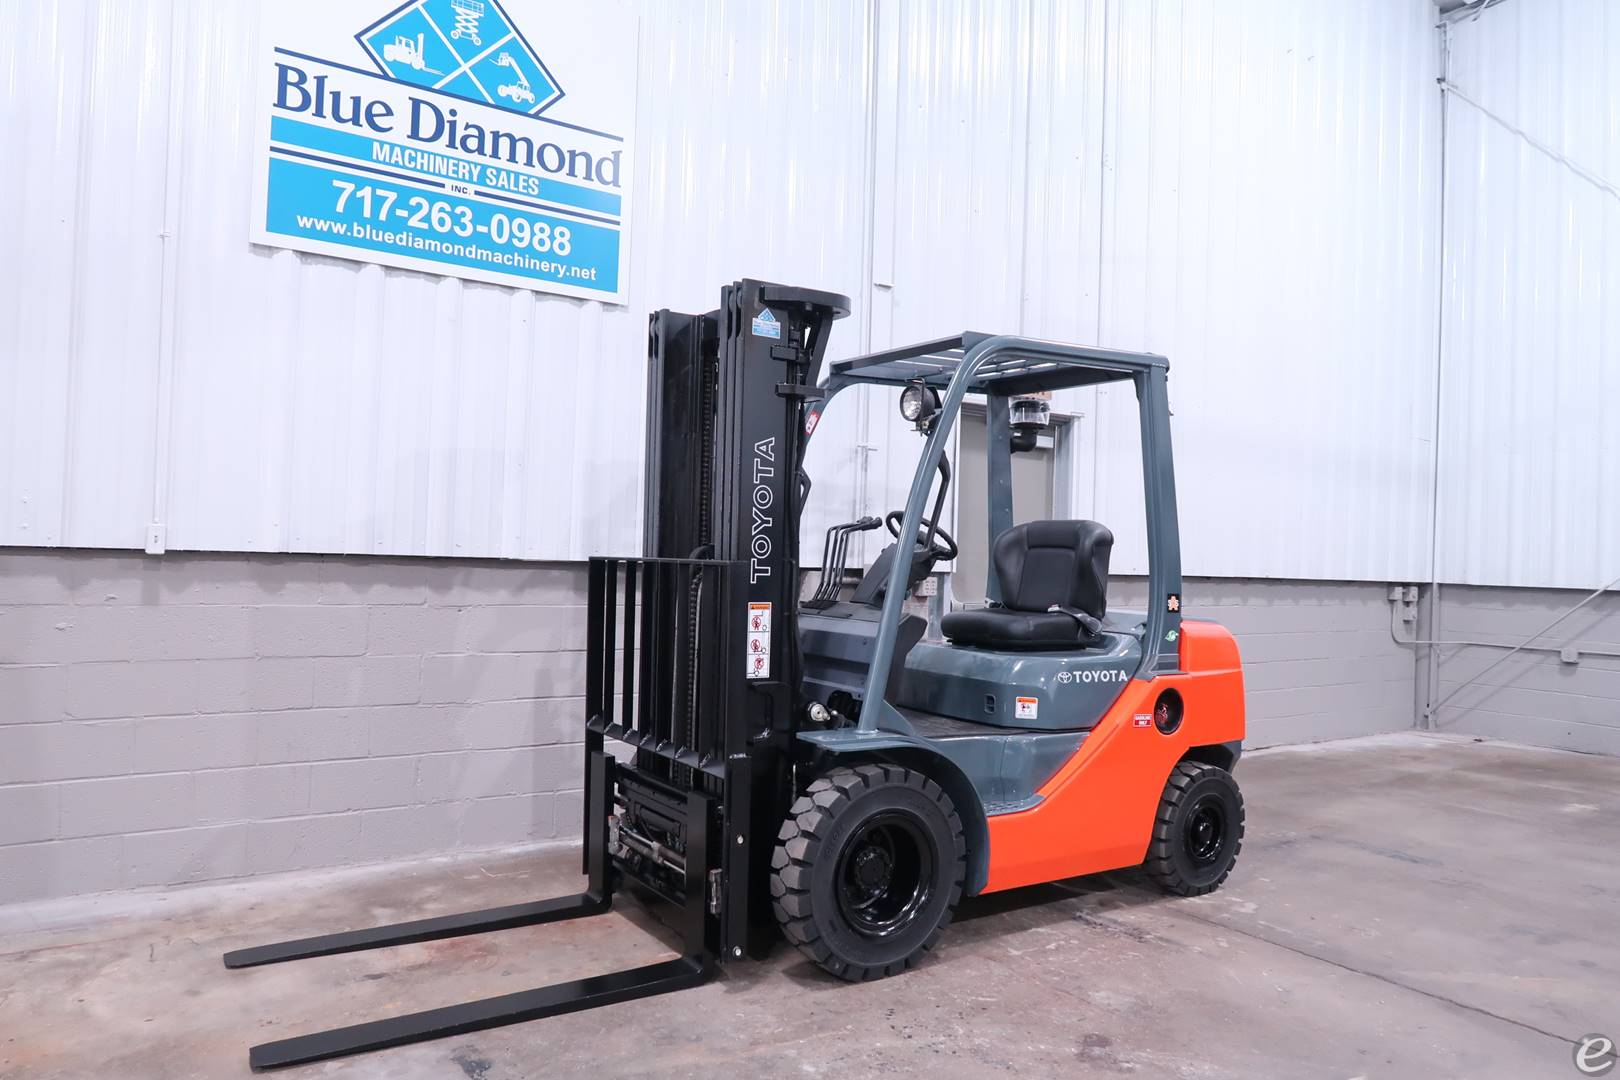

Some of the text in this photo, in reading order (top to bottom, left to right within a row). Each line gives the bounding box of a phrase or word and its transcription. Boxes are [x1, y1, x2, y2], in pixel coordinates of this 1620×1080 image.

[272, 62, 623, 188] Blue Diamond
[372, 142, 540, 196] MACHINERY SALES
[451, 184, 471, 195] INC.
[297, 215, 597, 281] www.bluediamondmachinery.net
[332, 180, 572, 256] 717-263-0988
[750, 436, 775, 584] TOYOTA
[1072, 669, 1128, 684] TOYOTA
